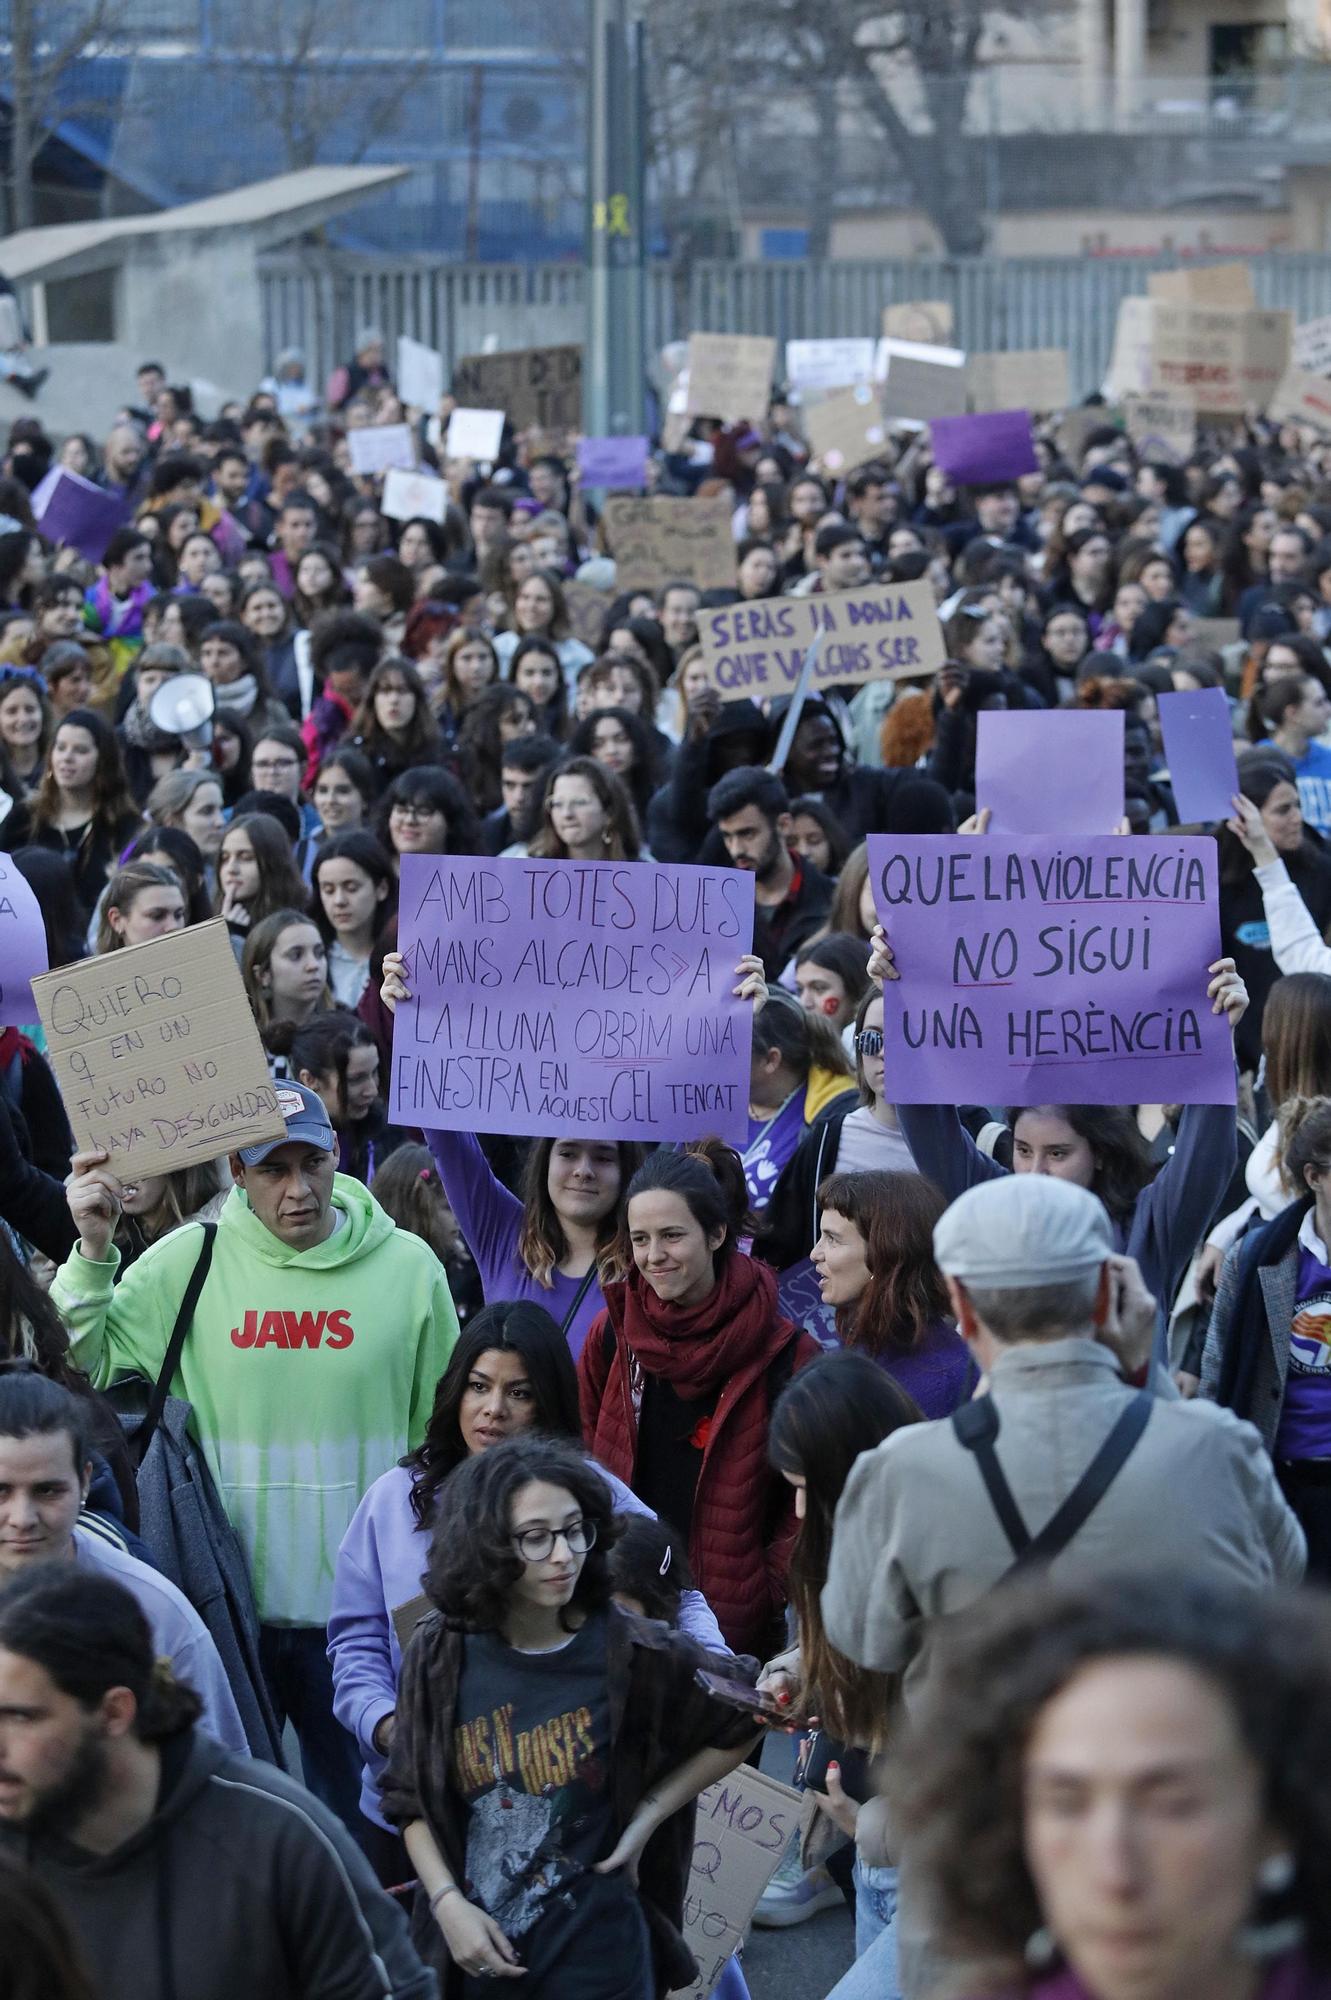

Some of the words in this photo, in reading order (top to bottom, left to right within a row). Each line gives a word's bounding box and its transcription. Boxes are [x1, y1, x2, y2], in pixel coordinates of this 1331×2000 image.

[847, 596, 913, 625] DONA
[714, 652, 768, 688] QUE
[774, 642, 871, 680] VLGUIS
[876, 637, 921, 669] SER
[881, 853, 975, 906] QUE
[984, 852, 1026, 901] LA
[415, 869, 511, 924] AMB
[524, 869, 636, 930] TOTES
[653, 873, 740, 938] DUES
[688, 947, 711, 997] A
[952, 927, 1019, 984] NO
[110, 1030, 144, 1059] EN
[159, 1015, 190, 1042] UN
[415, 995, 452, 1049] LA
[466, 1002, 556, 1053] LLUNA
[574, 1008, 672, 1059] OBRIM
[686, 1015, 737, 1057] UNA
[902, 1003, 982, 1049] UNA
[183, 1061, 218, 1086] NO
[398, 1055, 531, 1113] FINESTRA
[540, 1061, 568, 1092] EN
[609, 1070, 659, 1123] CEL
[537, 1096, 608, 1123] AQUEST
[665, 1084, 738, 1114] TENCAT
[230, 1309, 355, 1350] JAWS
